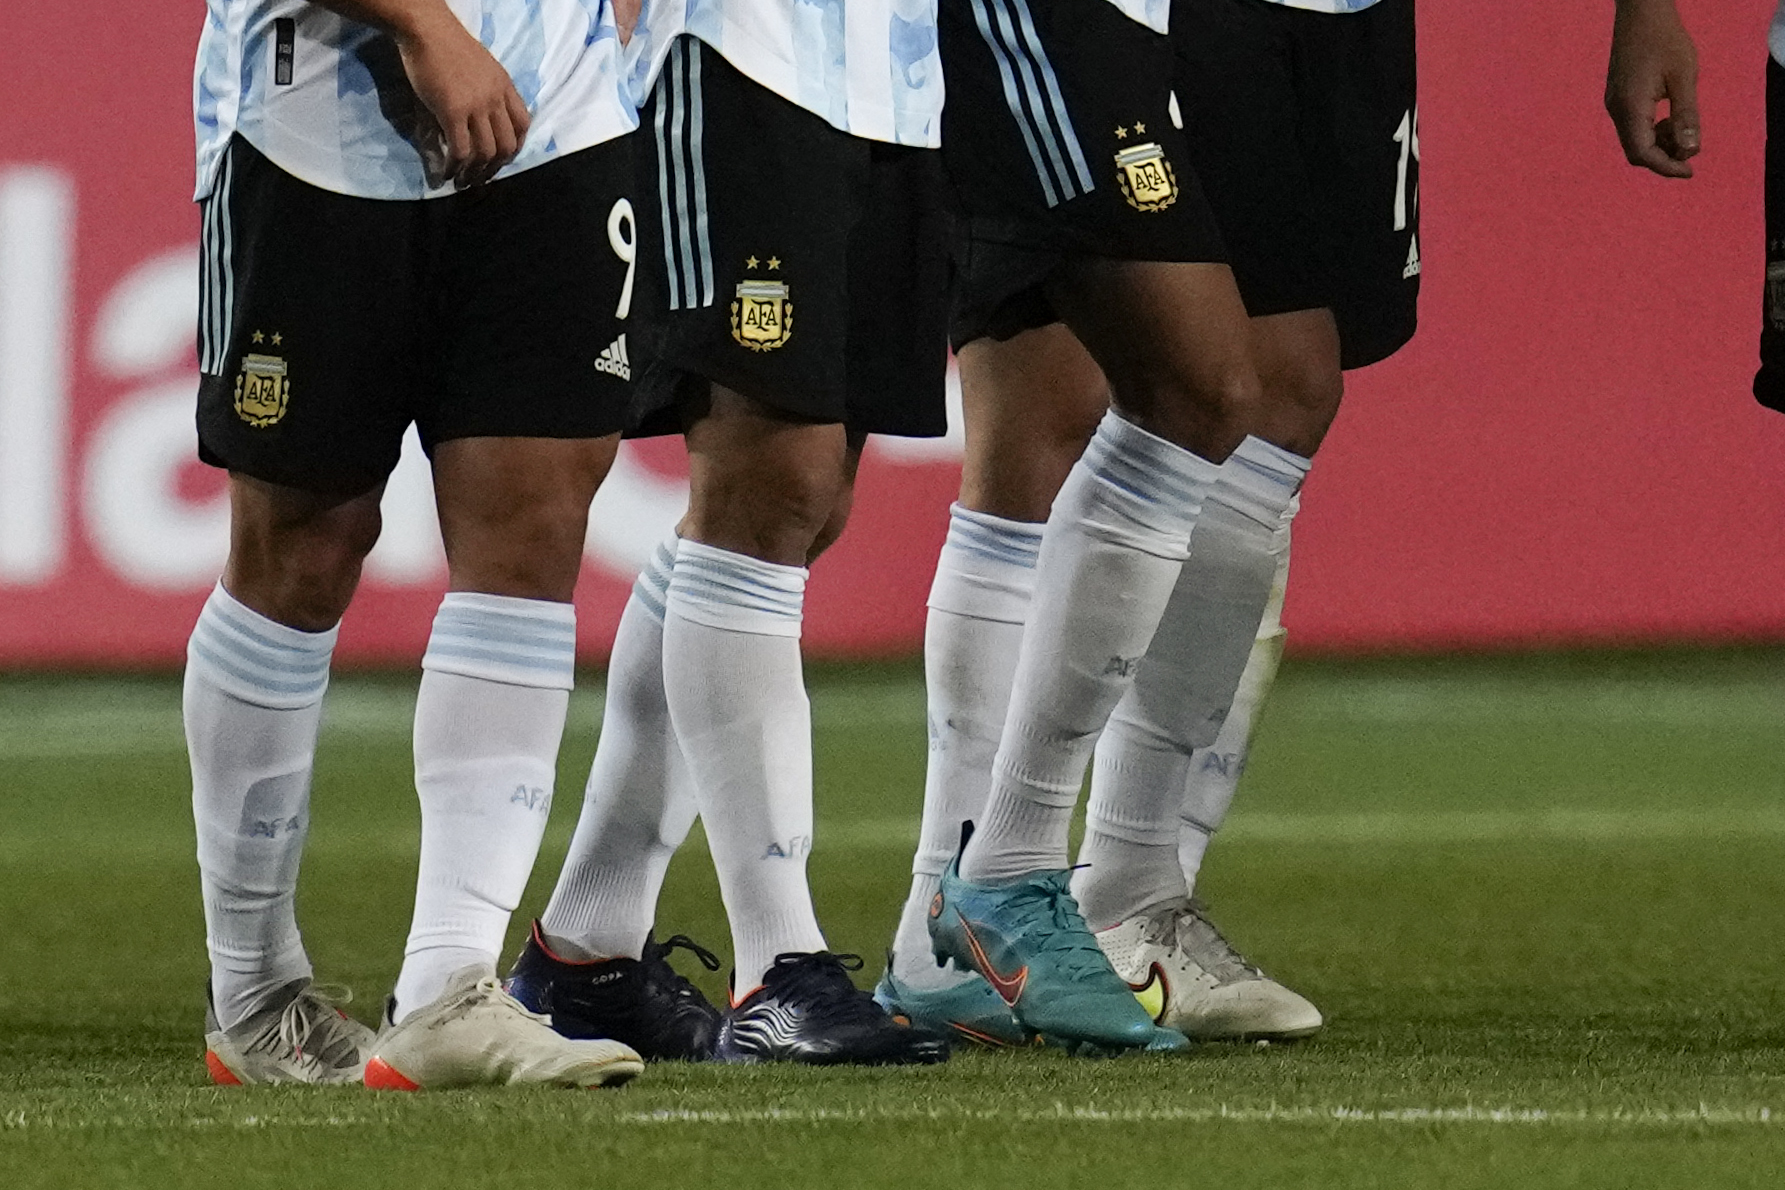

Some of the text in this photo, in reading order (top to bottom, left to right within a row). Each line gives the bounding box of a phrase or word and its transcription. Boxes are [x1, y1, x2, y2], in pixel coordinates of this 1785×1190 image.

[1134, 162, 1165, 192] AFA
[1393, 103, 1420, 232] 1
[607, 197, 637, 321] 9
[744, 299, 778, 332] AFA
[594, 357, 631, 382] adida
[246, 374, 277, 407] AFA
